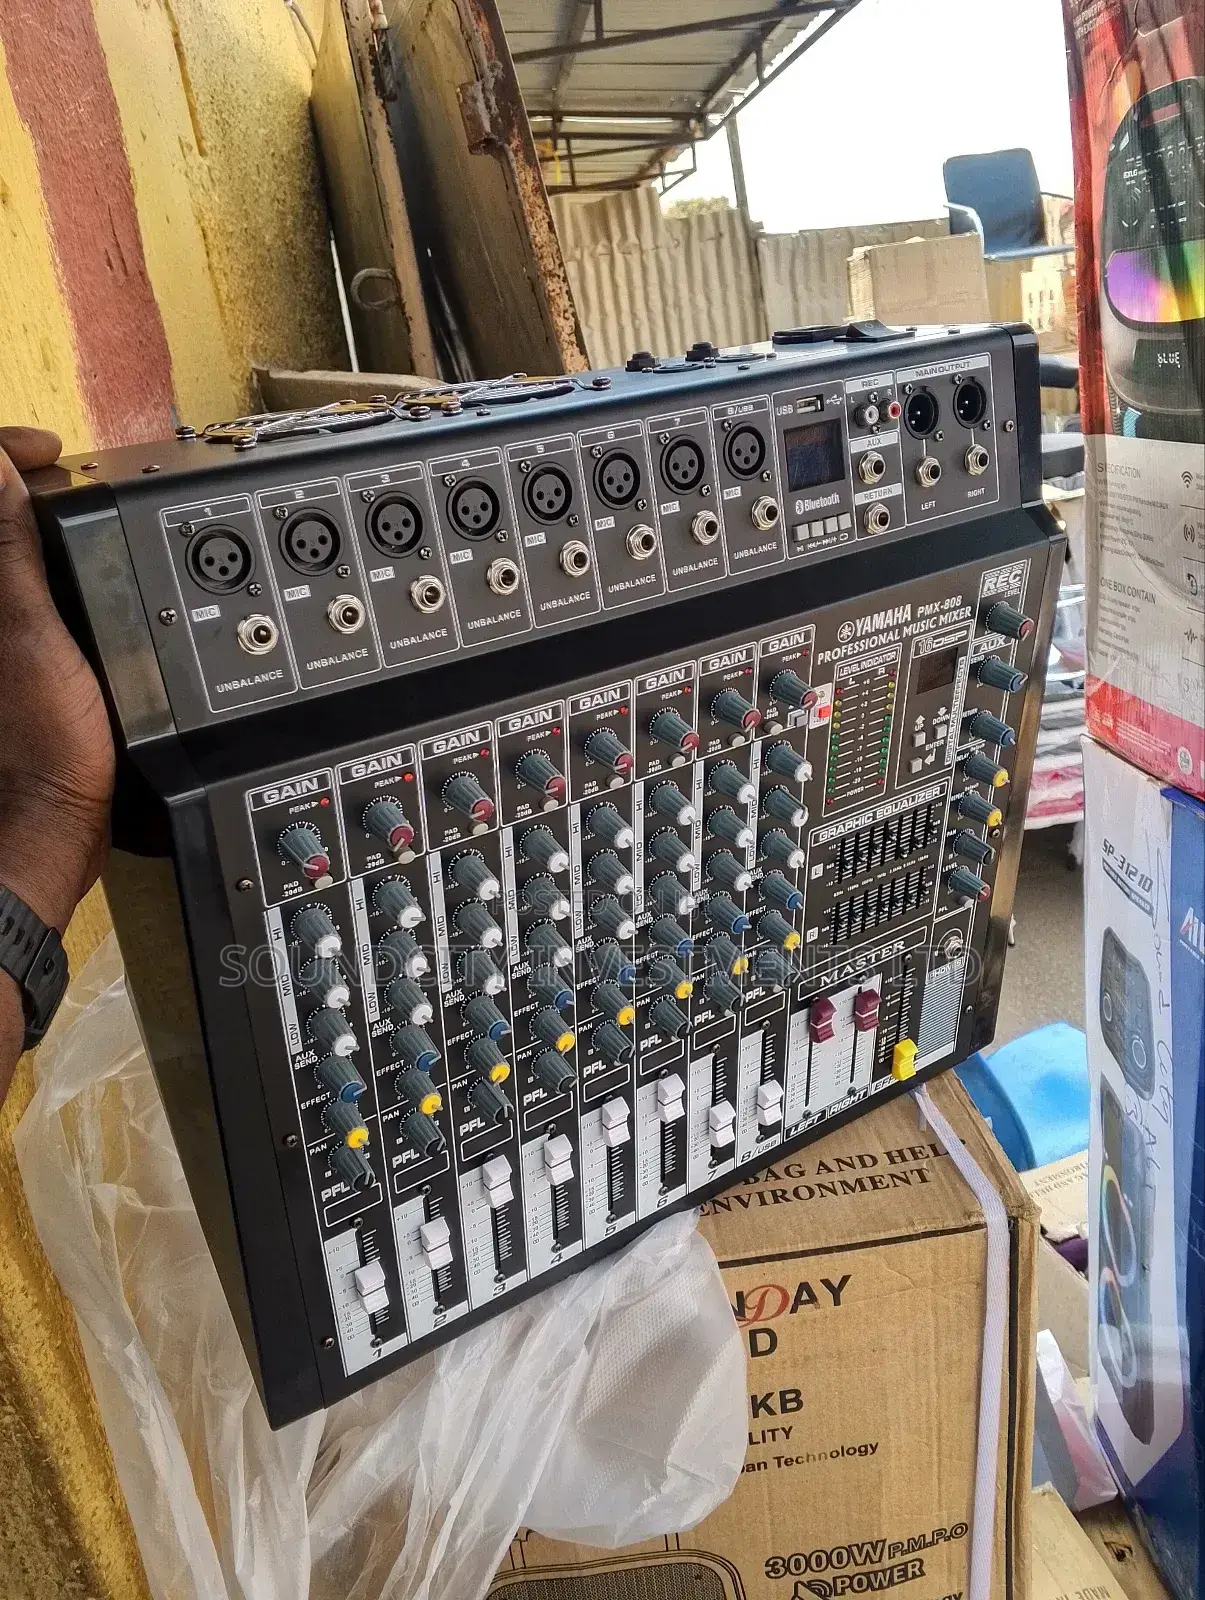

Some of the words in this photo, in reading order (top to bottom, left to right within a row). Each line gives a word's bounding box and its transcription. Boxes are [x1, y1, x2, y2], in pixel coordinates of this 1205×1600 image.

[862, 378, 879, 388] REC
[776, 404, 793, 417] USB
[673, 418, 681, 426] 7
[607, 430, 616, 440] 6
[536, 444, 546, 454] 5
[867, 438, 882, 448] AUX
[461, 459, 470, 468] 4
[380, 473, 391, 483] 3
[294, 489, 305, 500] 2
[725, 488, 741, 498] MIC
[864, 487, 892, 501] RETURN
[967, 487, 985, 499] RIGHT
[662, 503, 679, 513] MIC
[804, 494, 840, 511] Bluetooth
[921, 500, 936, 511] LEFT
[203, 507, 212, 517] 1
[596, 518, 614, 529] MIC
[526, 534, 545, 546] MIC
[451, 551, 471, 562] MIC
[733, 541, 777, 560] UNBALANCE
[371, 568, 394, 581] MIC
[672, 558, 718, 577] UNBALANCE
[608, 574, 656, 593] UNBALANCE
[984, 570, 1022, 593] REC
[287, 587, 308, 599] MIC
[1004, 588, 1020, 598] LEVEL
[540, 591, 591, 611] UNBALANCE
[194, 607, 218, 620] MIC
[467, 609, 521, 630] UNBALANCE
[855, 603, 912, 637] YAMAHA
[917, 595, 963, 618] PMX-808
[389, 628, 448, 650] UNBALANCE
[768, 632, 805, 652] GAIN
[817, 627, 900, 665] PROFESSIONAL
[903, 618, 936, 638] MUSIC
[938, 606, 972, 628] MIXER
[979, 634, 1006, 653] AUX
[306, 648, 369, 671] UNBALANCE
[709, 650, 747, 671] GAIN
[840, 662, 861, 676] LEVEL
[861, 651, 896, 670] INDICATOR
[216, 669, 284, 693] UNBALANCE
[645, 669, 686, 690] GAIN
[579, 688, 621, 710] GAIN
[508, 709, 553, 731] GAIN
[915, 723, 924, 731] UP
[933, 714, 951, 726] DOWN
[433, 730, 480, 753] GAIN
[925, 739, 944, 750] ENTER
[351, 753, 402, 778] GAIN
[453, 753, 472, 765] PEAK
[374, 776, 395, 789] PEAK
[263, 777, 318, 804] GAIN
[847, 787, 864, 798] POWER
[289, 802, 312, 814] PEAK
[819, 812, 873, 842] GRAPHIC
[876, 786, 941, 820] EQUALIZER
[444, 827, 458, 836] PAD
[366, 852, 382, 863] PAD
[505, 845, 513, 858] HI
[433, 871, 441, 884] HI
[283, 880, 299, 891] PAD
[355, 897, 364, 911] HI
[508, 889, 516, 911] MID
[272, 926, 282, 941] HI
[438, 915, 446, 937] MID
[362, 944, 371, 966] MID
[513, 960, 530, 973] AUX
[819, 940, 905, 987] MASTER
[441, 963, 451, 985] LOW
[512, 966, 532, 980] SEND
[280, 974, 291, 997] MID
[576, 976, 601, 991] EFFECT
[444, 993, 465, 1008] SEND
[445, 988, 463, 1001] AUX
[745, 986, 766, 1003] PFL
[368, 991, 378, 1015] LOW
[514, 1001, 539, 1018] EFFECT
[372, 1017, 391, 1030] AUX
[694, 1010, 715, 1027] PFL
[289, 1022, 300, 1046] LOW
[371, 1023, 394, 1038] SEND
[447, 1029, 474, 1046] EFFECT
[640, 1034, 662, 1052] PFL
[294, 1055, 318, 1070] SEND
[295, 1049, 314, 1062] AUX
[517, 1050, 532, 1062] PAN
[376, 1059, 405, 1077] EFFECT
[583, 1060, 606, 1078] PFL
[452, 1079, 468, 1091] PAN
[301, 1091, 331, 1110] EFFECT
[523, 1088, 548, 1107] PFL
[830, 1089, 868, 1118] RIGHT
[383, 1109, 400, 1123] PAN
[459, 1117, 485, 1137] PFL
[789, 1113, 821, 1137] LEFT
[309, 1143, 327, 1156] PAN
[392, 1148, 420, 1168] PFL
[815, 1153, 879, 1176] AND
[882, 1139, 966, 1166] HEL
[707, 1169, 718, 1182] 7
[321, 1181, 350, 1202] PFL
[699, 1167, 932, 1217] ENVIRONMENT
[657, 1196, 668, 1208] 6
[605, 1225, 618, 1237] 5
[550, 1253, 564, 1265] 4
[493, 1283, 507, 1297] 3
[433, 1314, 448, 1329] 2
[372, 1348, 383, 1358] 1
[773, 1441, 879, 1469] Technology
[765, 1538, 888, 1580] 3000W
[834, 1558, 925, 1596] POWER
